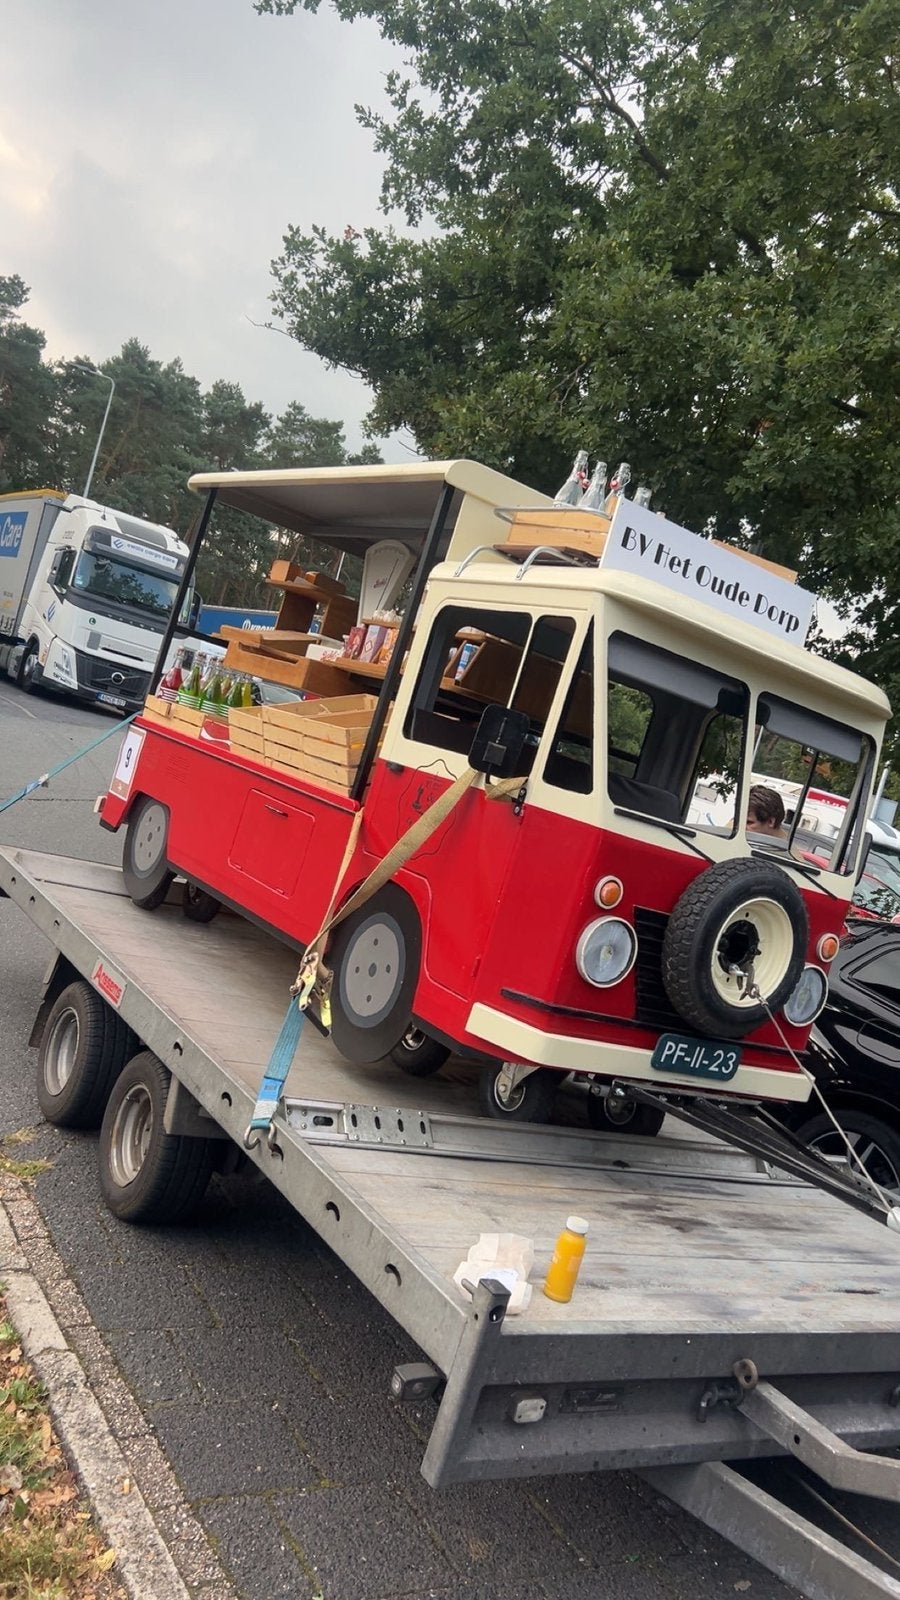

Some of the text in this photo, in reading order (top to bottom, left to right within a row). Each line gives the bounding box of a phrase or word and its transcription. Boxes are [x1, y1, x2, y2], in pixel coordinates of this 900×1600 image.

[1, 516, 22, 548] Care
[654, 543, 692, 579] Het
[696, 565, 750, 607] Oude
[753, 593, 799, 633] Dorp
[125, 747, 132, 768] 9
